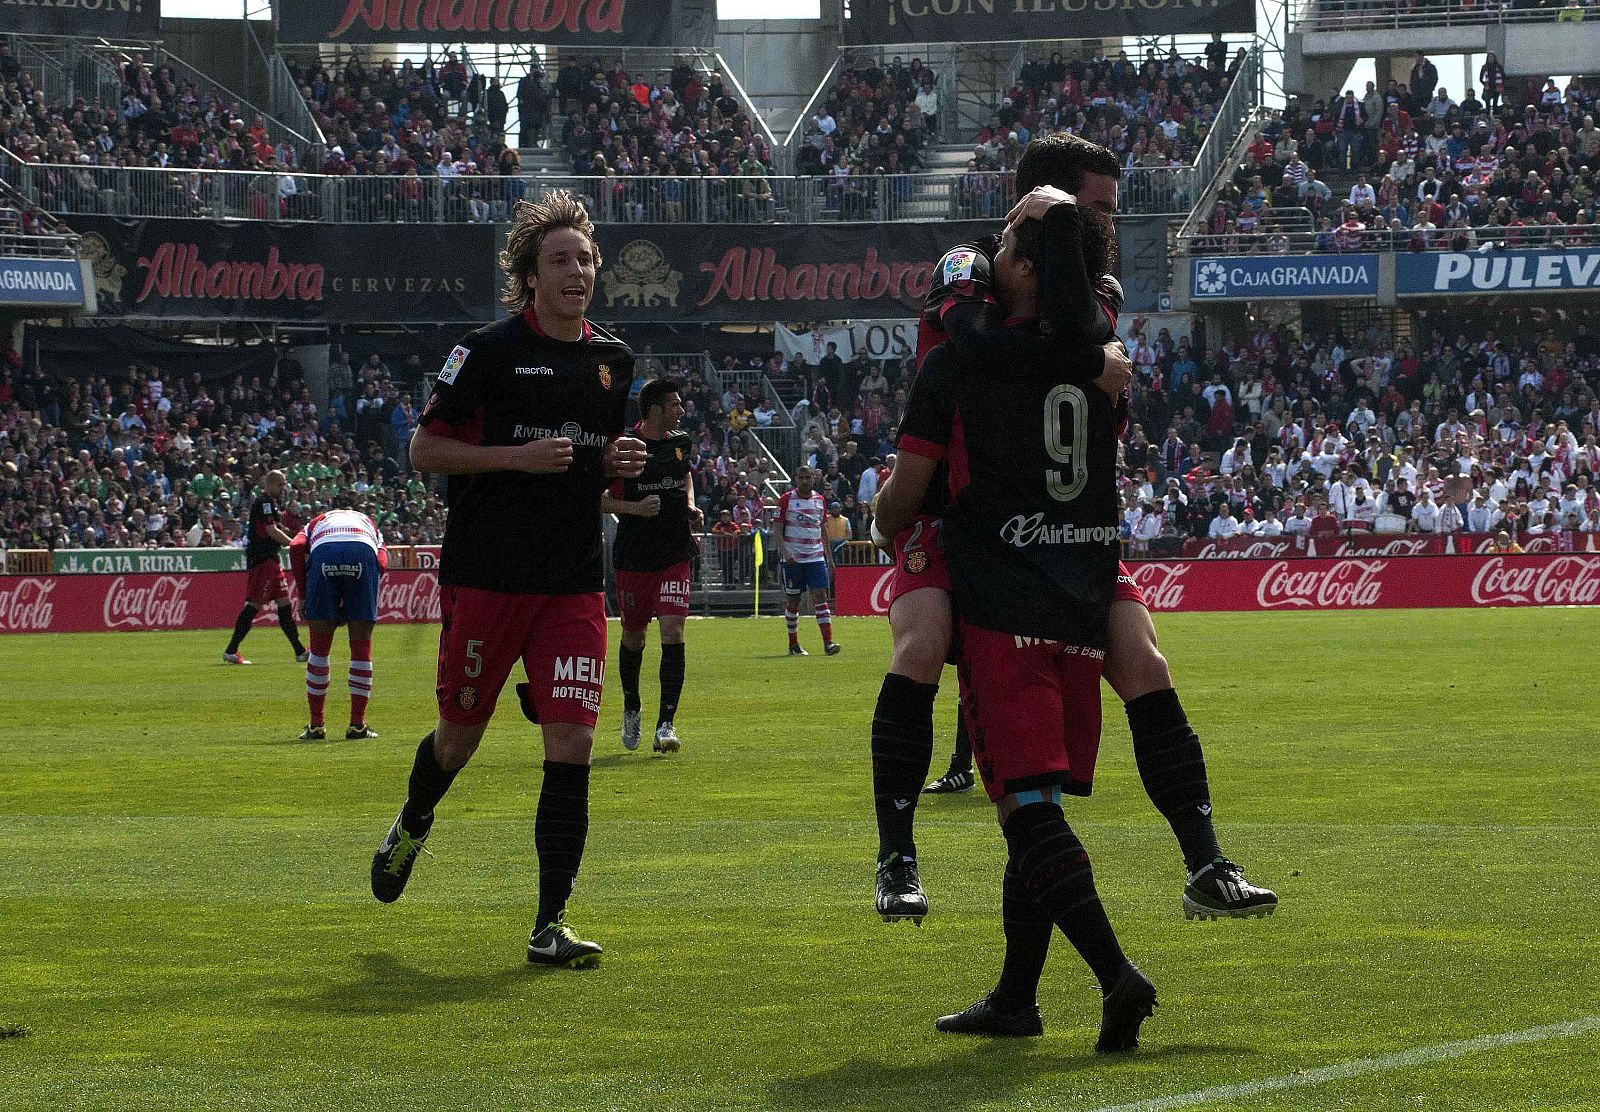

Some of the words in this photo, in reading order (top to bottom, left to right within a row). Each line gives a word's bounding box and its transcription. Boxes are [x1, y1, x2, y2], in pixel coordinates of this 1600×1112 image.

[136, 241, 323, 303] Alhambra
[331, 277, 466, 292] CERVEZAS
[697, 246, 936, 306] Alhambra
[1434, 253, 1600, 290] PULEV
[514, 366, 554, 376] macron
[1043, 383, 1089, 502] 9
[138, 555, 198, 573] RURAL
[1257, 560, 1389, 607] Coca-Cola
[1471, 557, 1600, 604] Coca-Cola
[103, 576, 192, 627] Coca-Cola
[465, 639, 484, 678] 5
[553, 656, 605, 685] MELI
[552, 686, 600, 703] HOTELES
